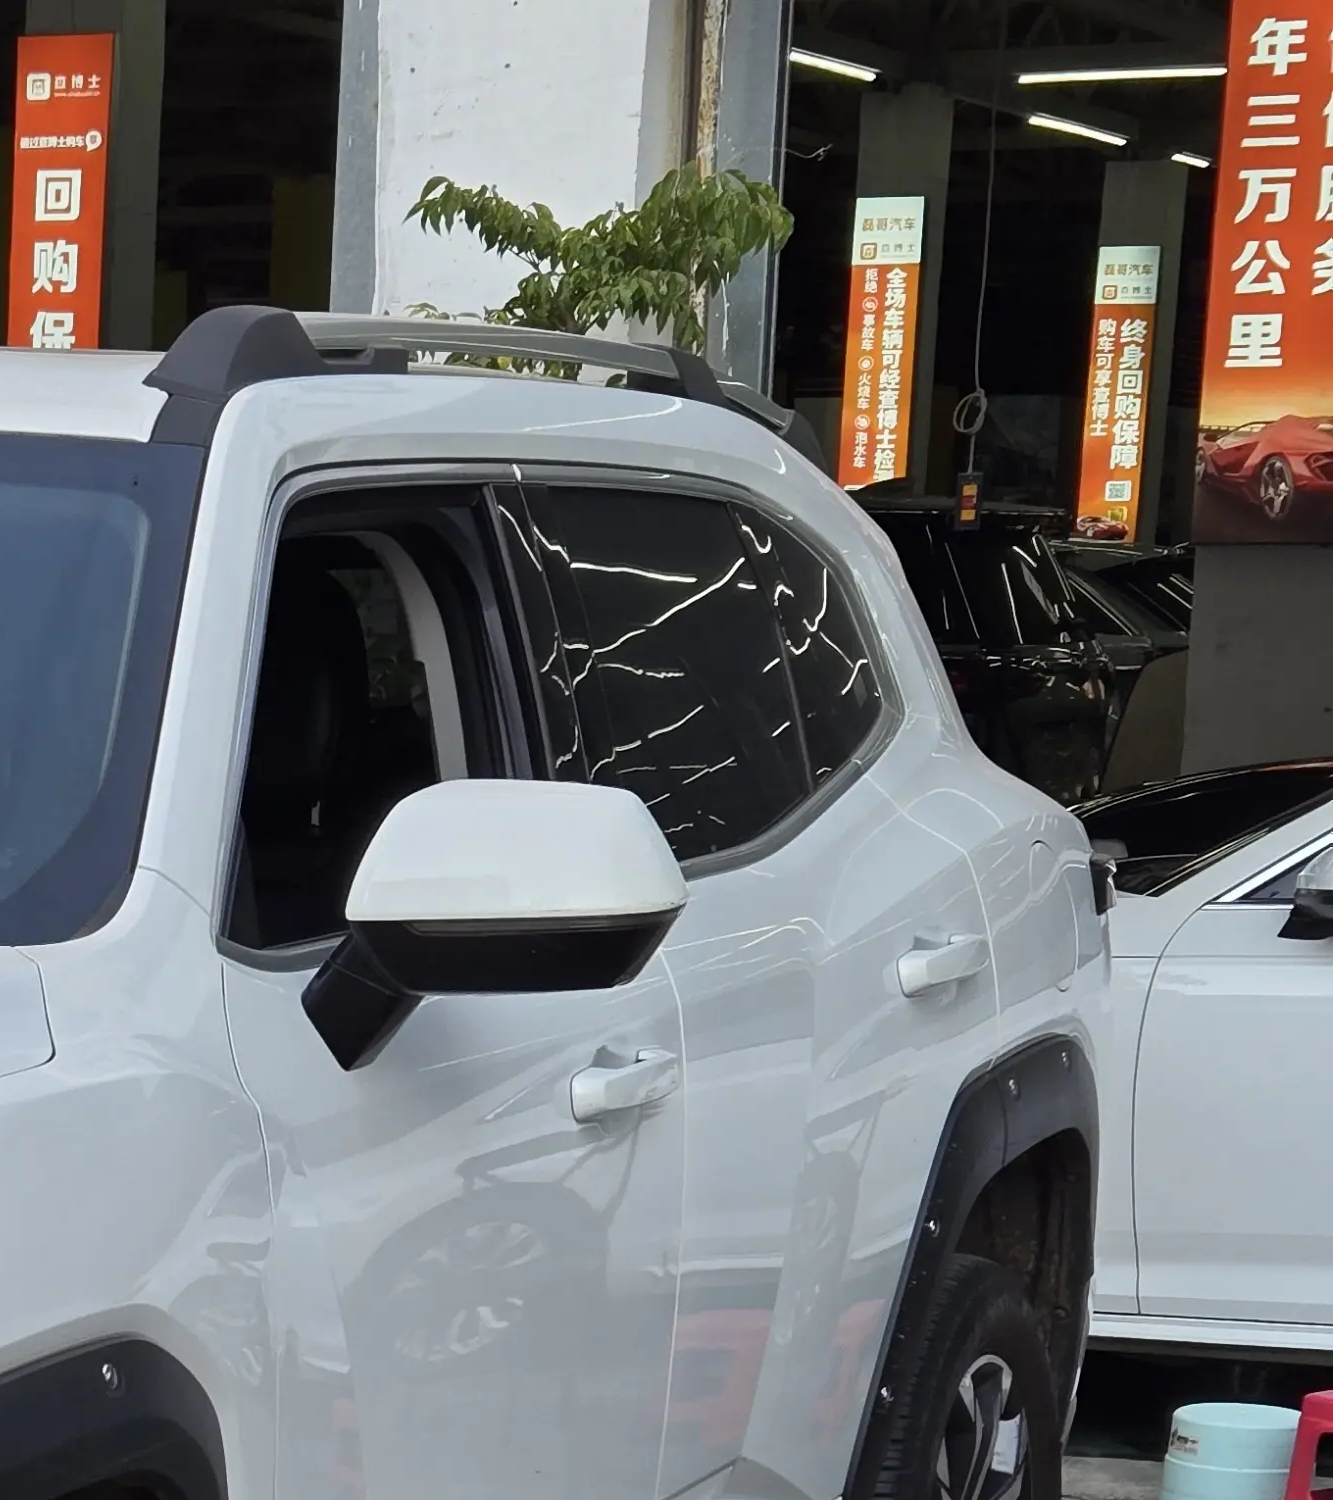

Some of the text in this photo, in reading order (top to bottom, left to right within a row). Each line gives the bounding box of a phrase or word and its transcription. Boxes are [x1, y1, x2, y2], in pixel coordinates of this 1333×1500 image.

[1224, 17, 1308, 368] 年三万公里
[1110, 318, 1148, 469] 终身回购保障
